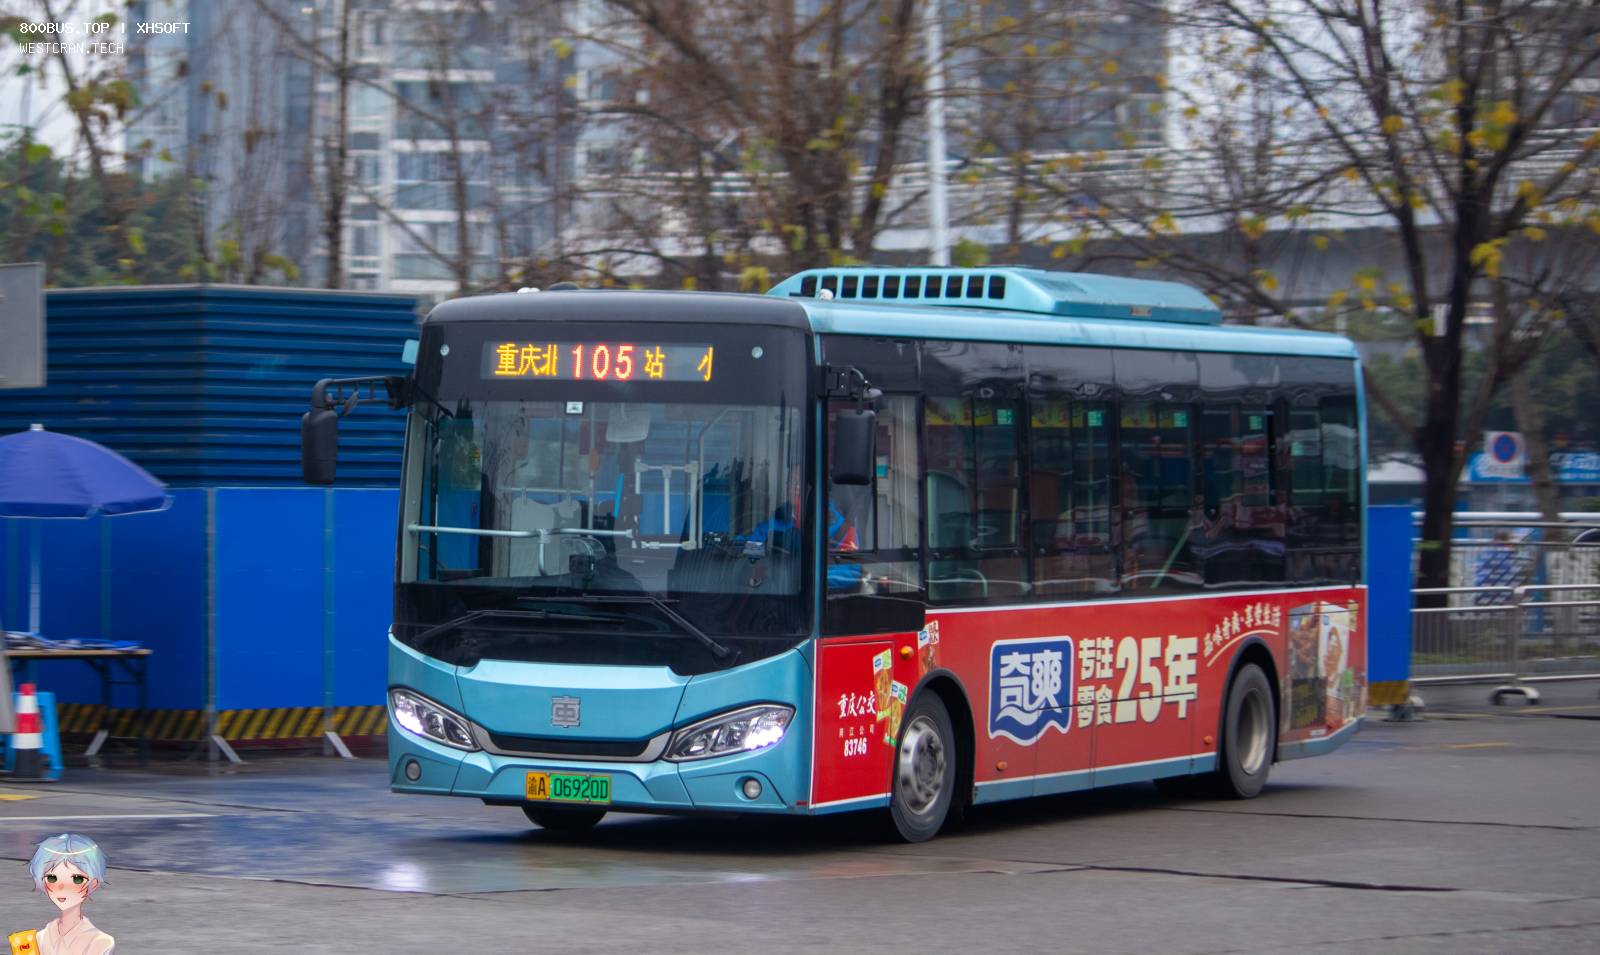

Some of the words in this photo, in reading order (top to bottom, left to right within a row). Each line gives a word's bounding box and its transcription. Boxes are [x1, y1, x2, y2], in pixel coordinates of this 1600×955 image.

[571, 344, 633, 379] 105
[645, 346, 665, 378] 站
[1078, 636, 1114, 680] 专注
[997, 649, 1063, 722] 奇爽
[1115, 635, 1198, 723] 25年
[837, 690, 876, 719] 重庆公交
[1077, 684, 1113, 728] 零食
[843, 737, 867, 757] 83746
[553, 777, 609, 799] 06920D
